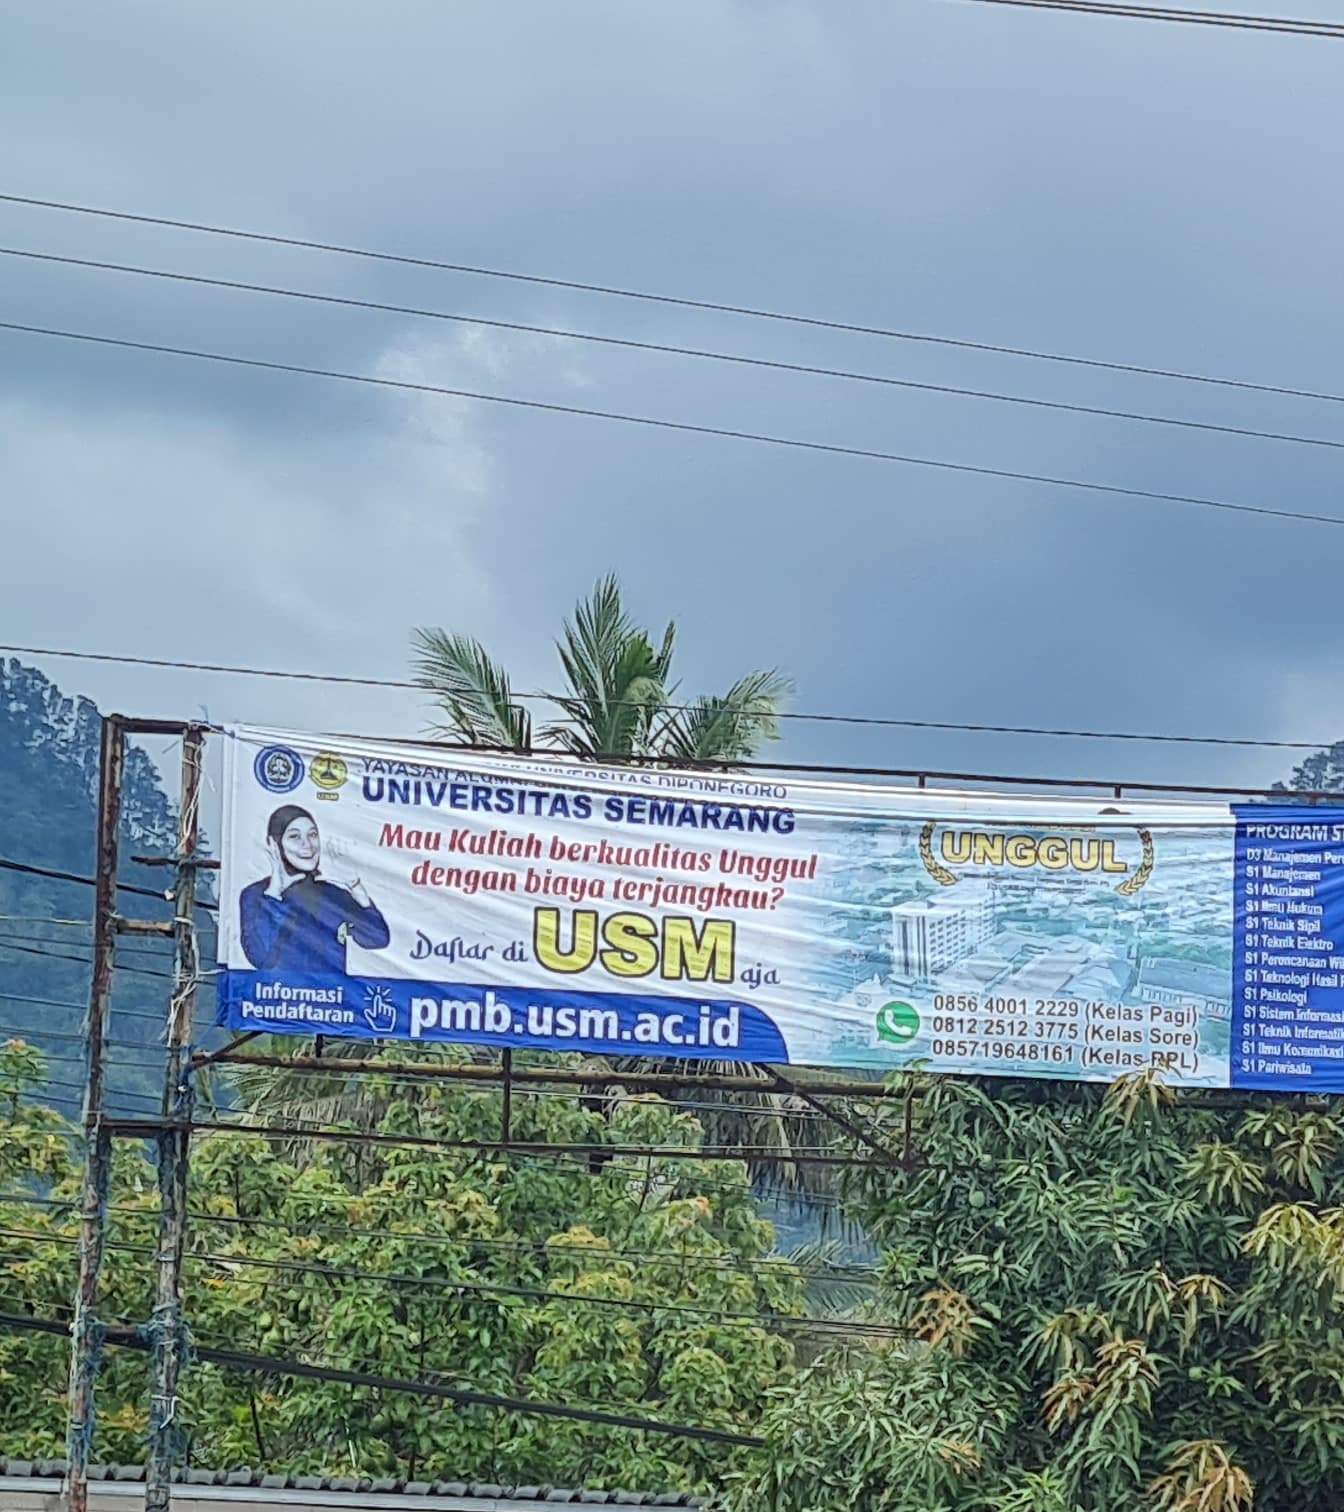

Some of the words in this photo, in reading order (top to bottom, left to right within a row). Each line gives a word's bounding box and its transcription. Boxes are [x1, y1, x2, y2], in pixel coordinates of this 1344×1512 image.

[361, 758, 449, 781] YAYASAN
[361, 776, 592, 820] UNIVERSITAS
[604, 796, 796, 834] SEMARANG
[1246, 824, 1328, 841] PROGRAM
[378, 822, 441, 851] Mau
[448, 828, 542, 859] Kuliah
[548, 834, 711, 873] berkualitas
[718, 848, 818, 883] Unggul
[940, 830, 1129, 873] UNGGUL
[411, 859, 517, 895] dengan
[524, 868, 606, 904] biaya
[612, 876, 786, 913] terjangkau?
[409, 929, 494, 964] Daftar
[502, 939, 530, 962] di
[533, 906, 737, 984] USM
[740, 962, 782, 991] aja
[255, 982, 344, 1004] Informasi
[933, 993, 979, 1013] 0856
[983, 997, 1028, 1016] 4001
[1034, 1000, 1080, 1018] 2229
[1084, 1002, 1145, 1024] (Kelas
[1148, 1005, 1198, 1028] Pagi)
[242, 1001, 355, 1024] Pendaftaran
[409, 990, 741, 1048] pmb.usm.ac.id
[932, 1015, 978, 1035] 0812
[983, 1019, 1028, 1037] 2512
[1034, 1022, 1079, 1040] 3775
[1083, 1024, 1144, 1044] (Kelas
[1148, 1027, 1199, 1050] Sore)
[932, 1038, 1075, 1063] 085719648161
[1081, 1045, 1145, 1067] (Kelas
